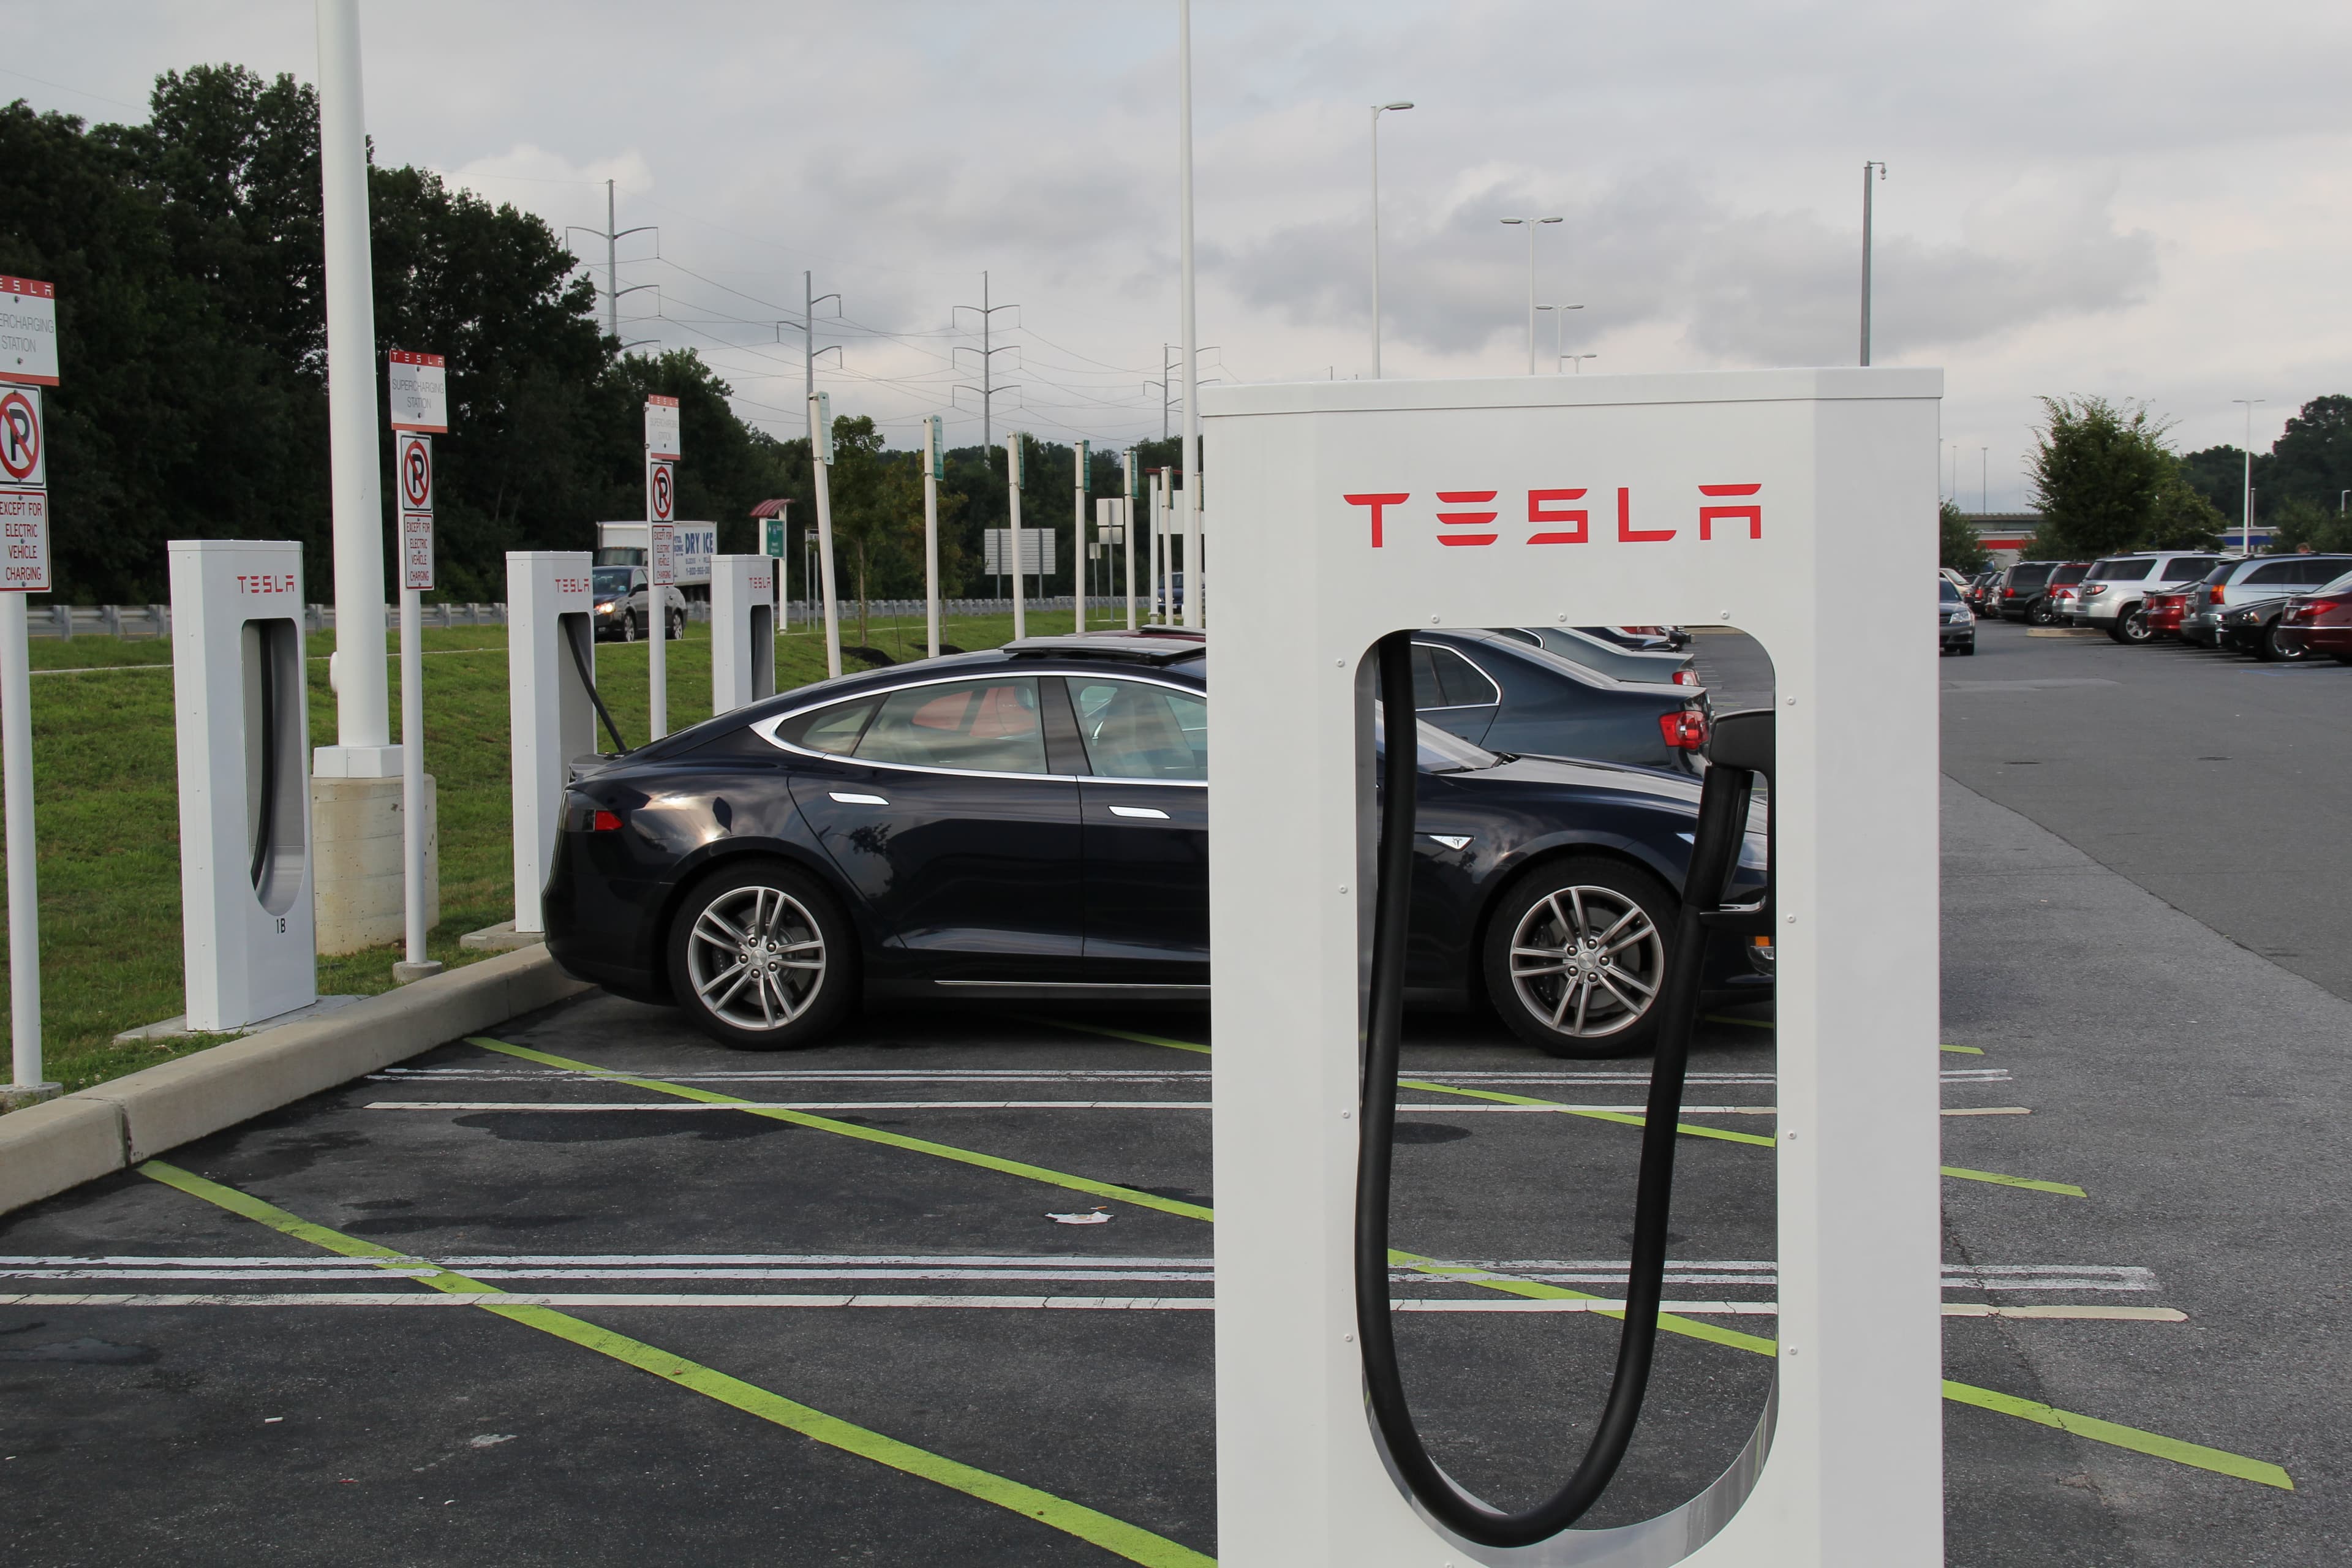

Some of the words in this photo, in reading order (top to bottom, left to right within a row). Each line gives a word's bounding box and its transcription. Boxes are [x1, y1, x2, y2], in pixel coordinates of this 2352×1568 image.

[2, 335, 37, 353] STATION
[392, 352, 443, 366] TESLA
[391, 379, 445, 394] SUPERCHARGING
[407, 396, 432, 409] STATION
[650, 395, 679, 407] TESLA
[0, 501, 25, 516] EXCEPT
[29, 502, 42, 516] FOR
[1343, 483, 1762, 548] TESLA
[5, 524, 38, 538] ELECTRIC
[406, 522, 421, 533] EXCEPT
[422, 522, 431, 533] FOR
[410, 538, 428, 549] ELECTRIC
[685, 532, 700, 554] DRY
[703, 532, 713, 554] ICE
[8, 545, 37, 559] VEHICLE
[411, 554, 427, 565] VEHICLE
[6, 566, 42, 581] CHARGING
[410, 570, 429, 581] CHARGING
[236, 575, 295, 594] TESLA
[555, 578, 589, 593] TESLA
[748, 577, 772, 589] TESLA
[276, 918, 286, 933] 1B
